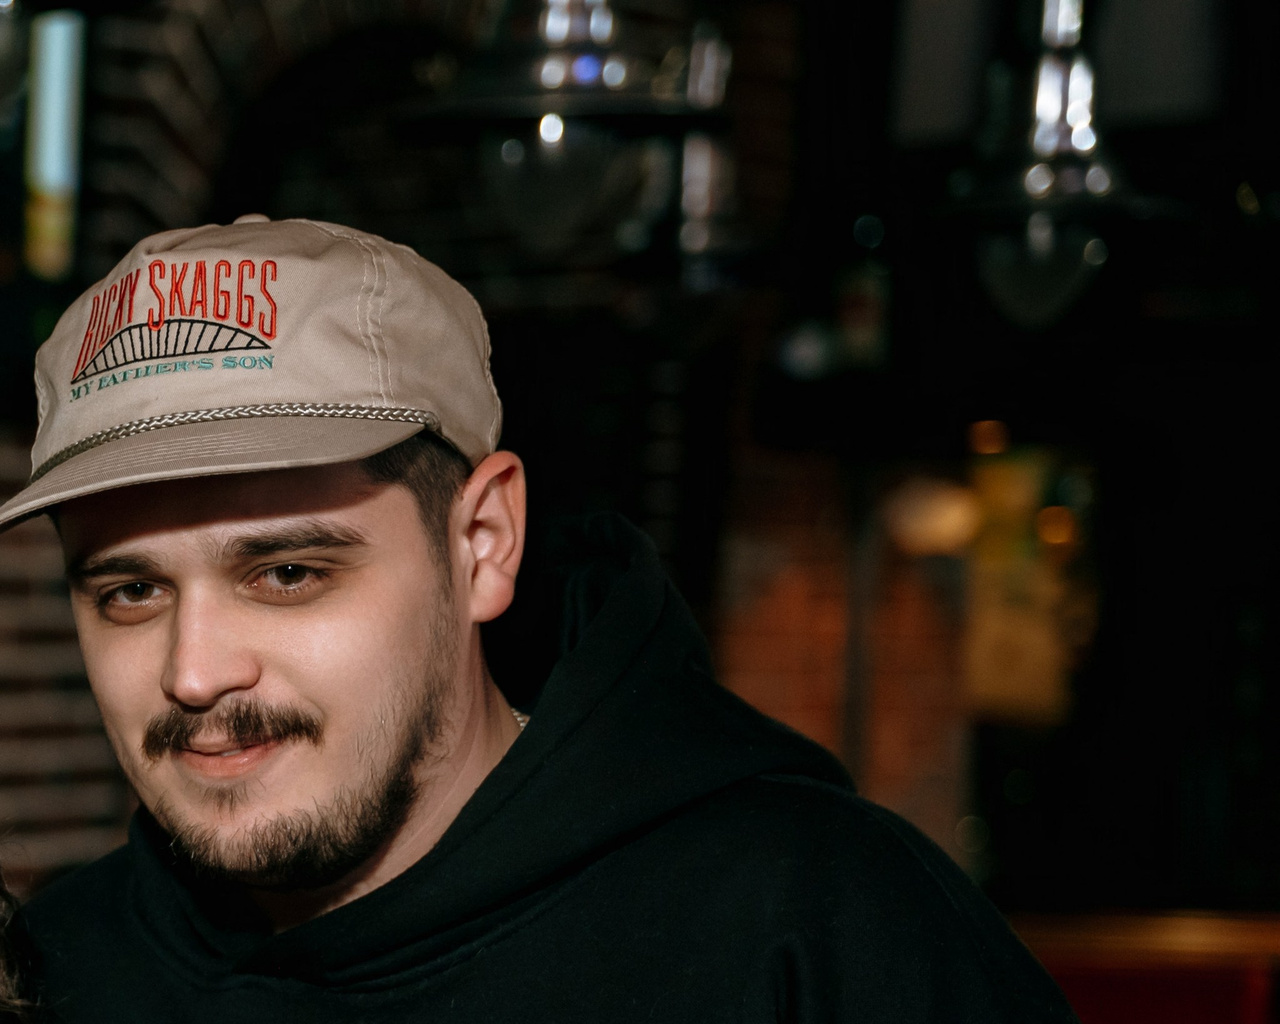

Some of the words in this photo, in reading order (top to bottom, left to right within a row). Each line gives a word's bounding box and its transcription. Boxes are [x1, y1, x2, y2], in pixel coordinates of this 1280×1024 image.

[72, 268, 141, 380] RICKY
[147, 259, 277, 341] SKAGGS
[70, 383, 93, 403] MY
[97, 357, 214, 392] FATHER'S
[222, 355, 275, 370] SON
